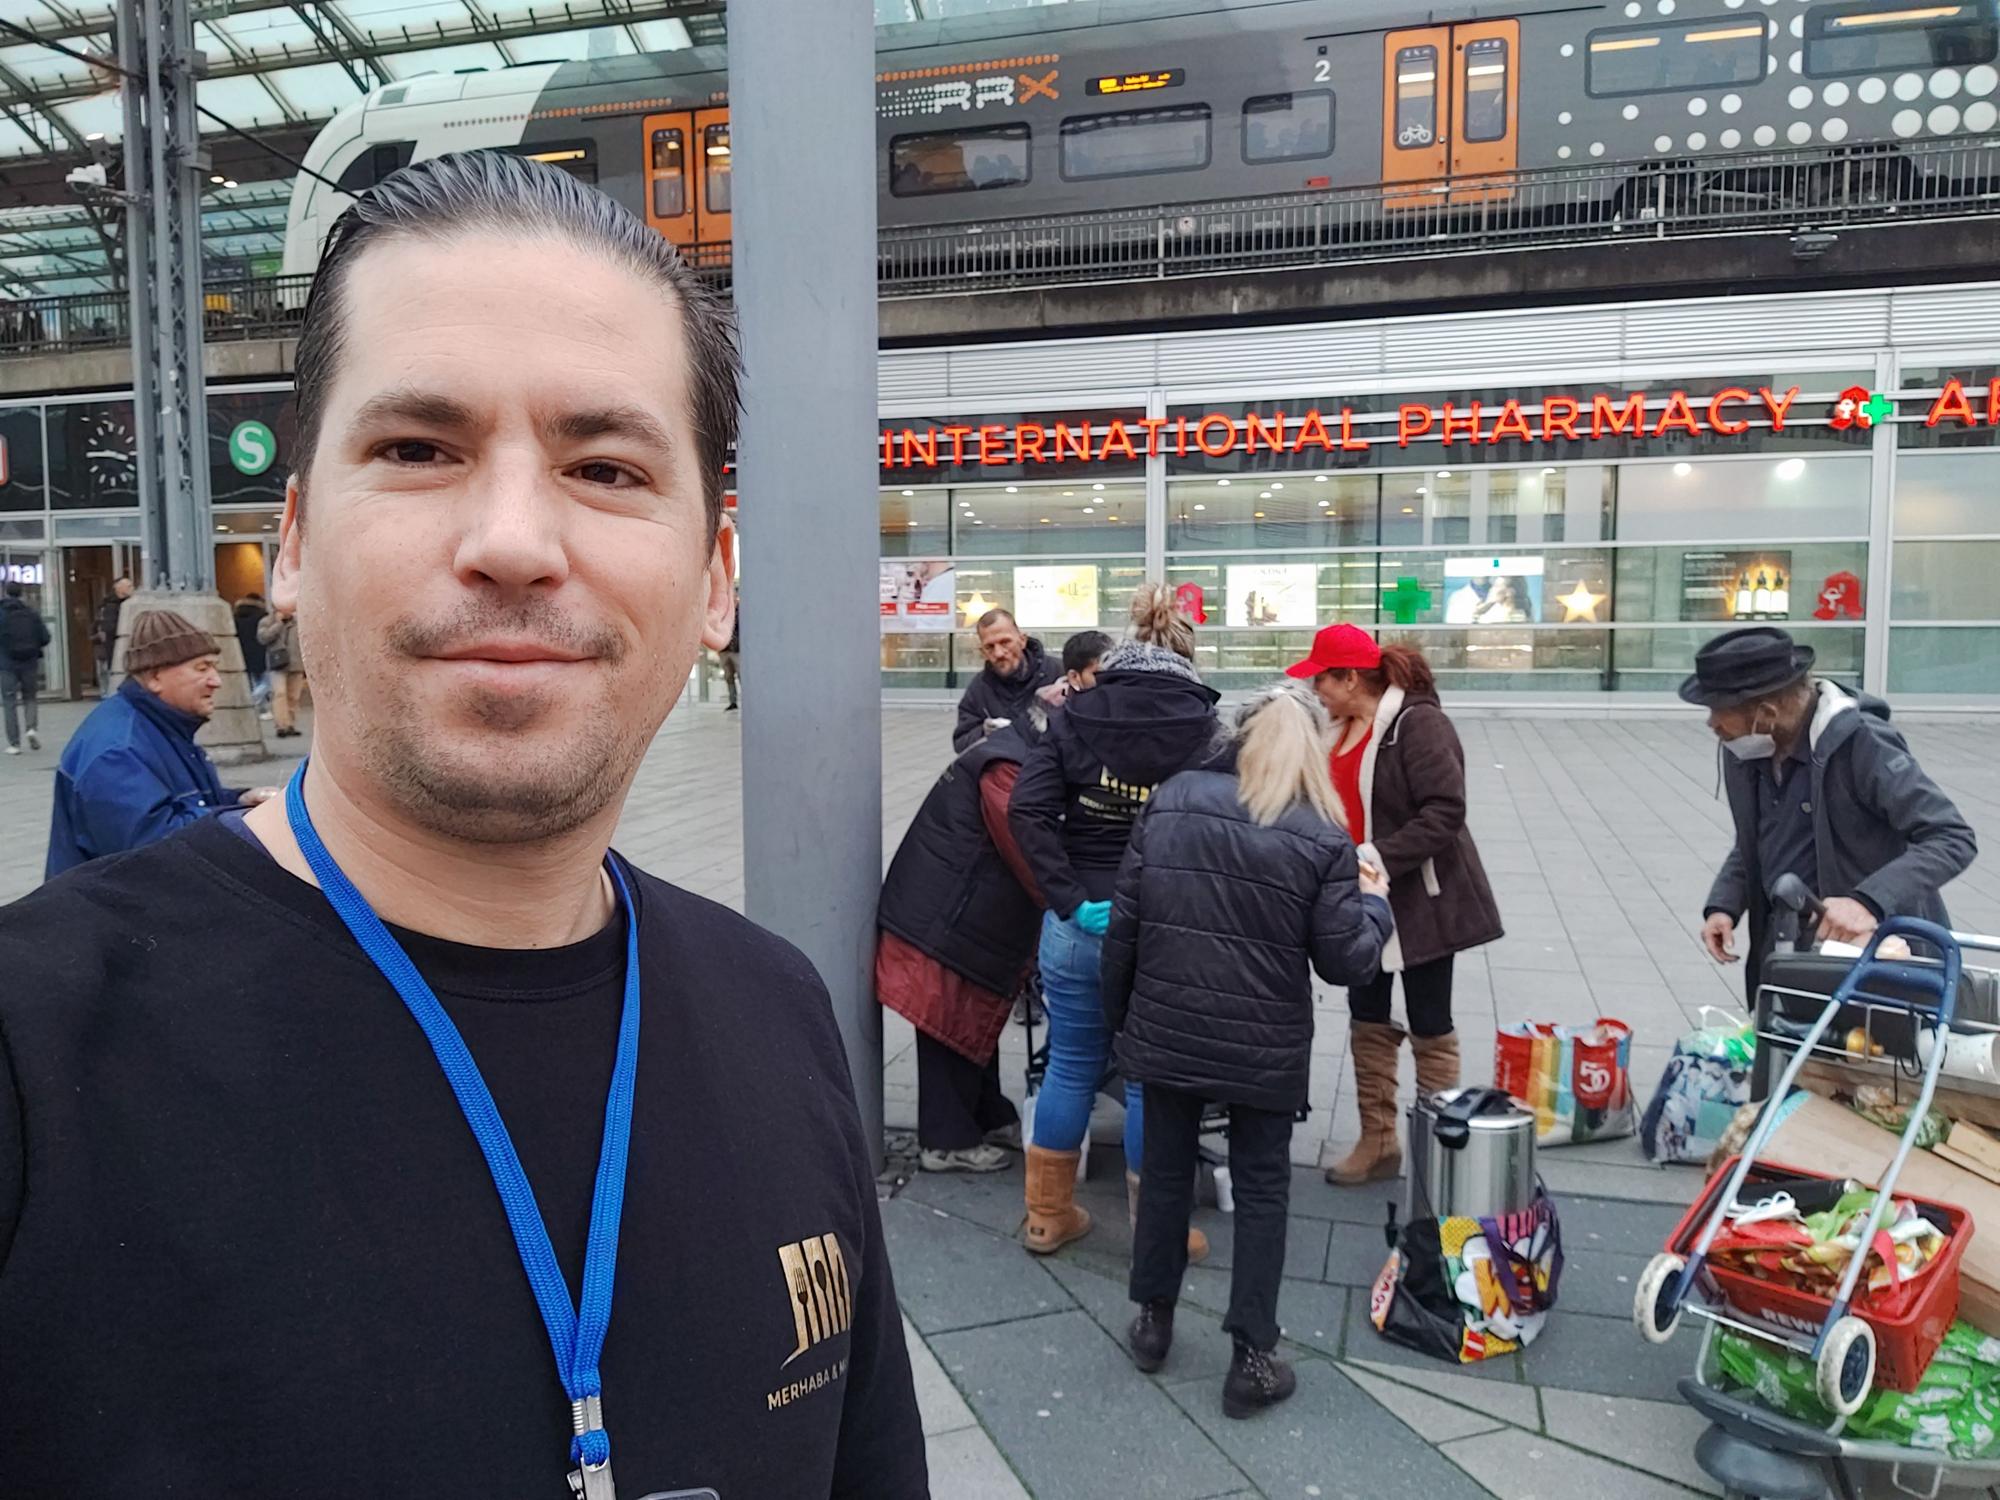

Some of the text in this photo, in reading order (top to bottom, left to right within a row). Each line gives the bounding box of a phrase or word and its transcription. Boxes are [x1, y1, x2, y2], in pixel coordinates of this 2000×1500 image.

[934, 70, 1060, 115] RRX
[1314, 59, 1331, 82] 2
[236, 426, 267, 470] S
[884, 384, 1801, 469] INTERNATIONAL PHARMACY
[767, 1368, 830, 1411] MERHABA
[831, 1362, 839, 1381] &
